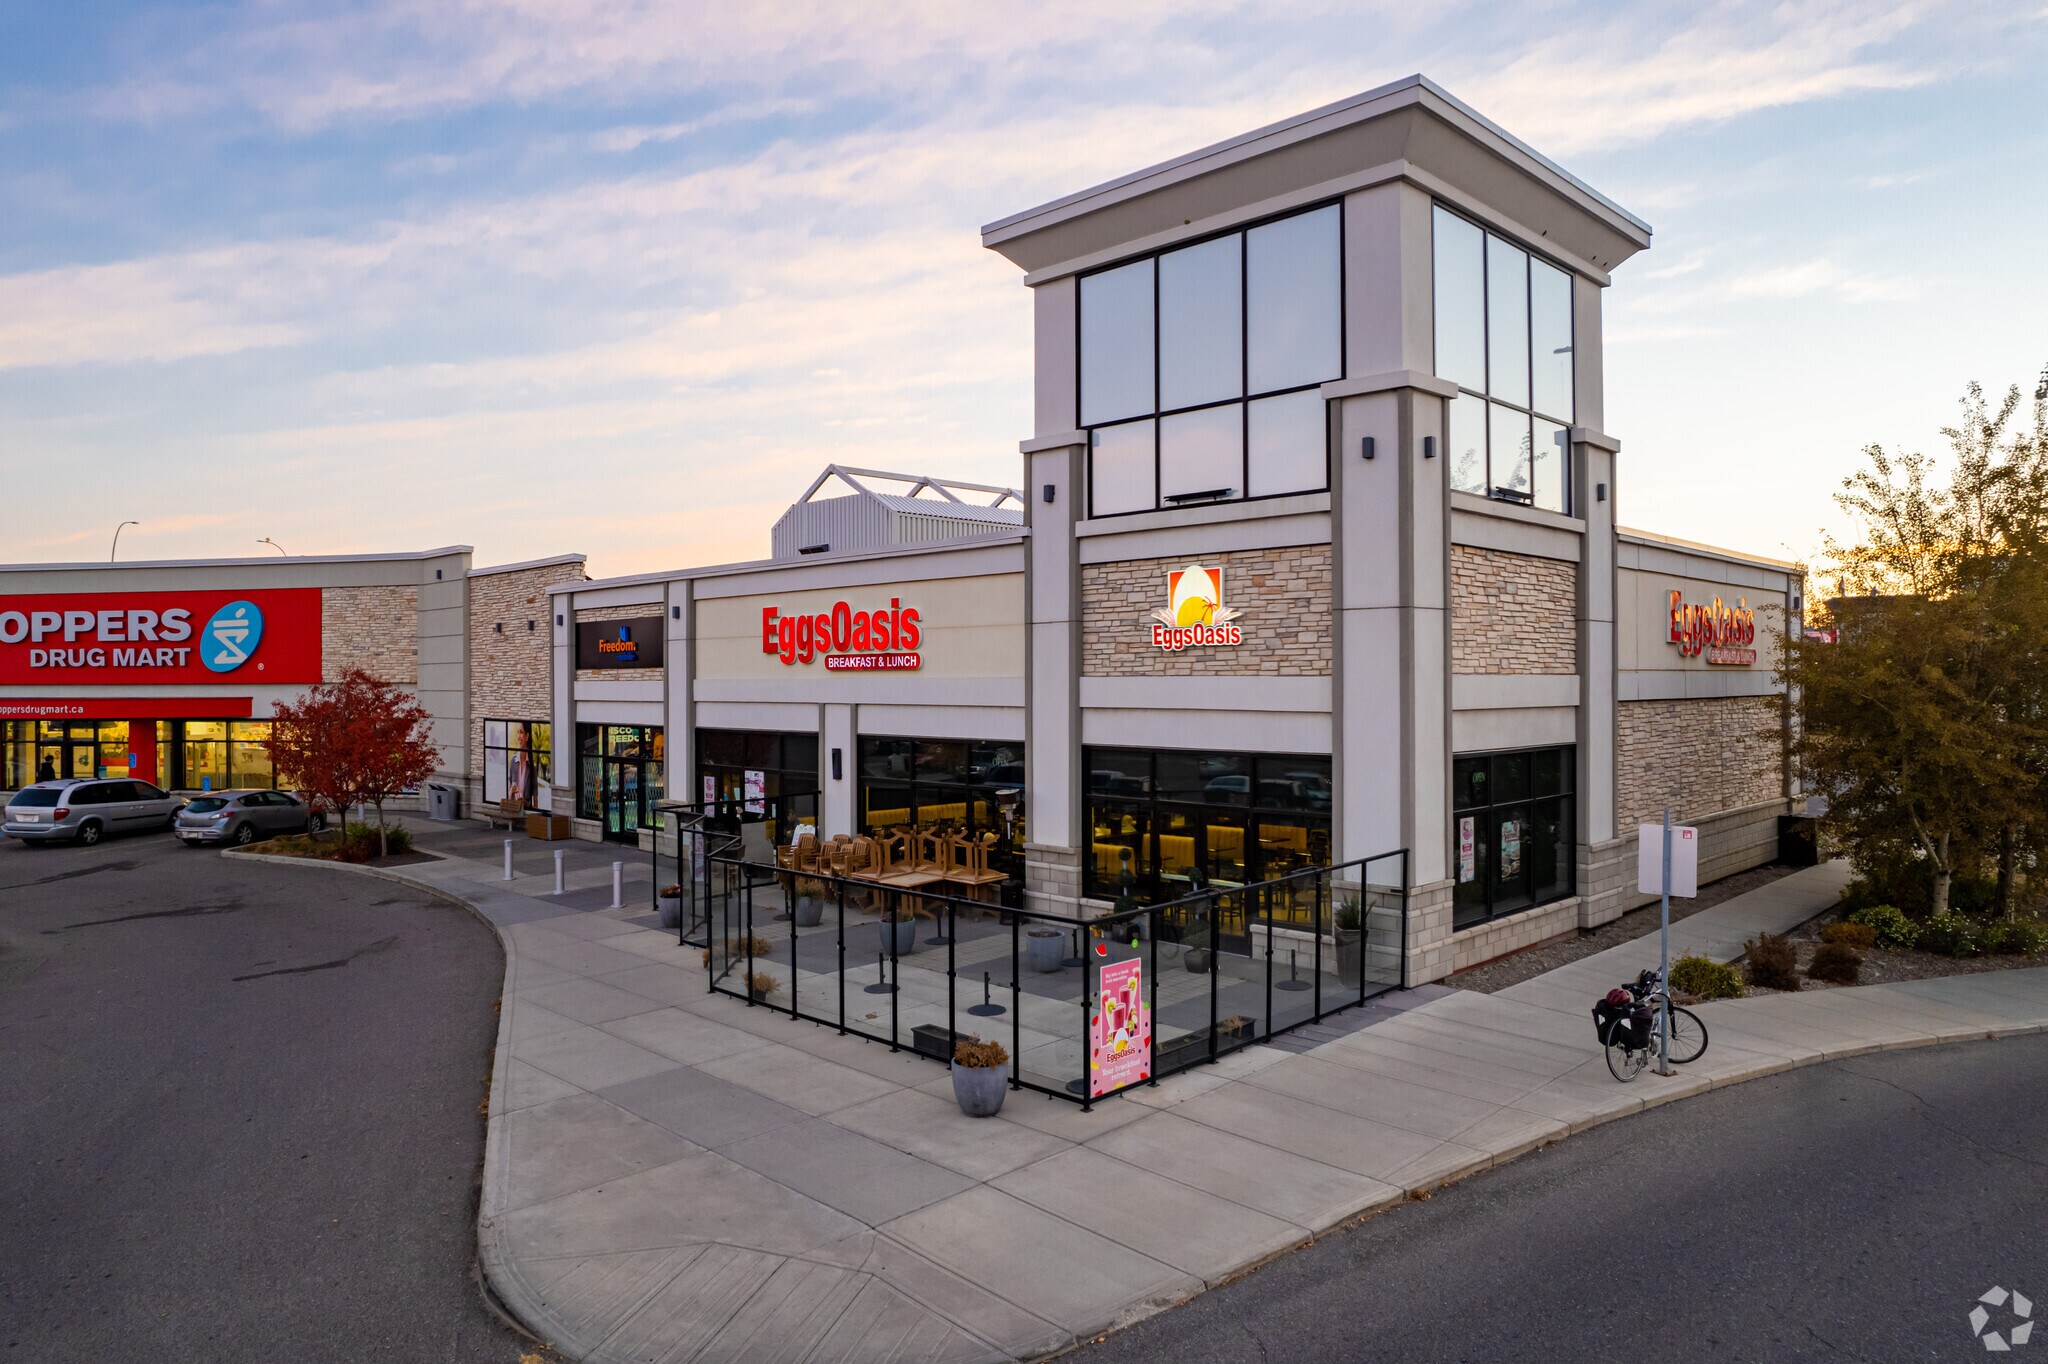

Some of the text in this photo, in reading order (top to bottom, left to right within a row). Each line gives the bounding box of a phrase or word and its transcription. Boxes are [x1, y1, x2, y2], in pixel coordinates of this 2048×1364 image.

[762, 597, 921, 665] EggsOasis
[1668, 589, 1755, 656] EggsOasis
[1152, 622, 1241, 651] EggsOasis
[30, 647, 191, 667] DRUG MART
[828, 655, 917, 668] BREAKFAST & LUNCH
[1106, 1047, 1136, 1063] EggsOasis
